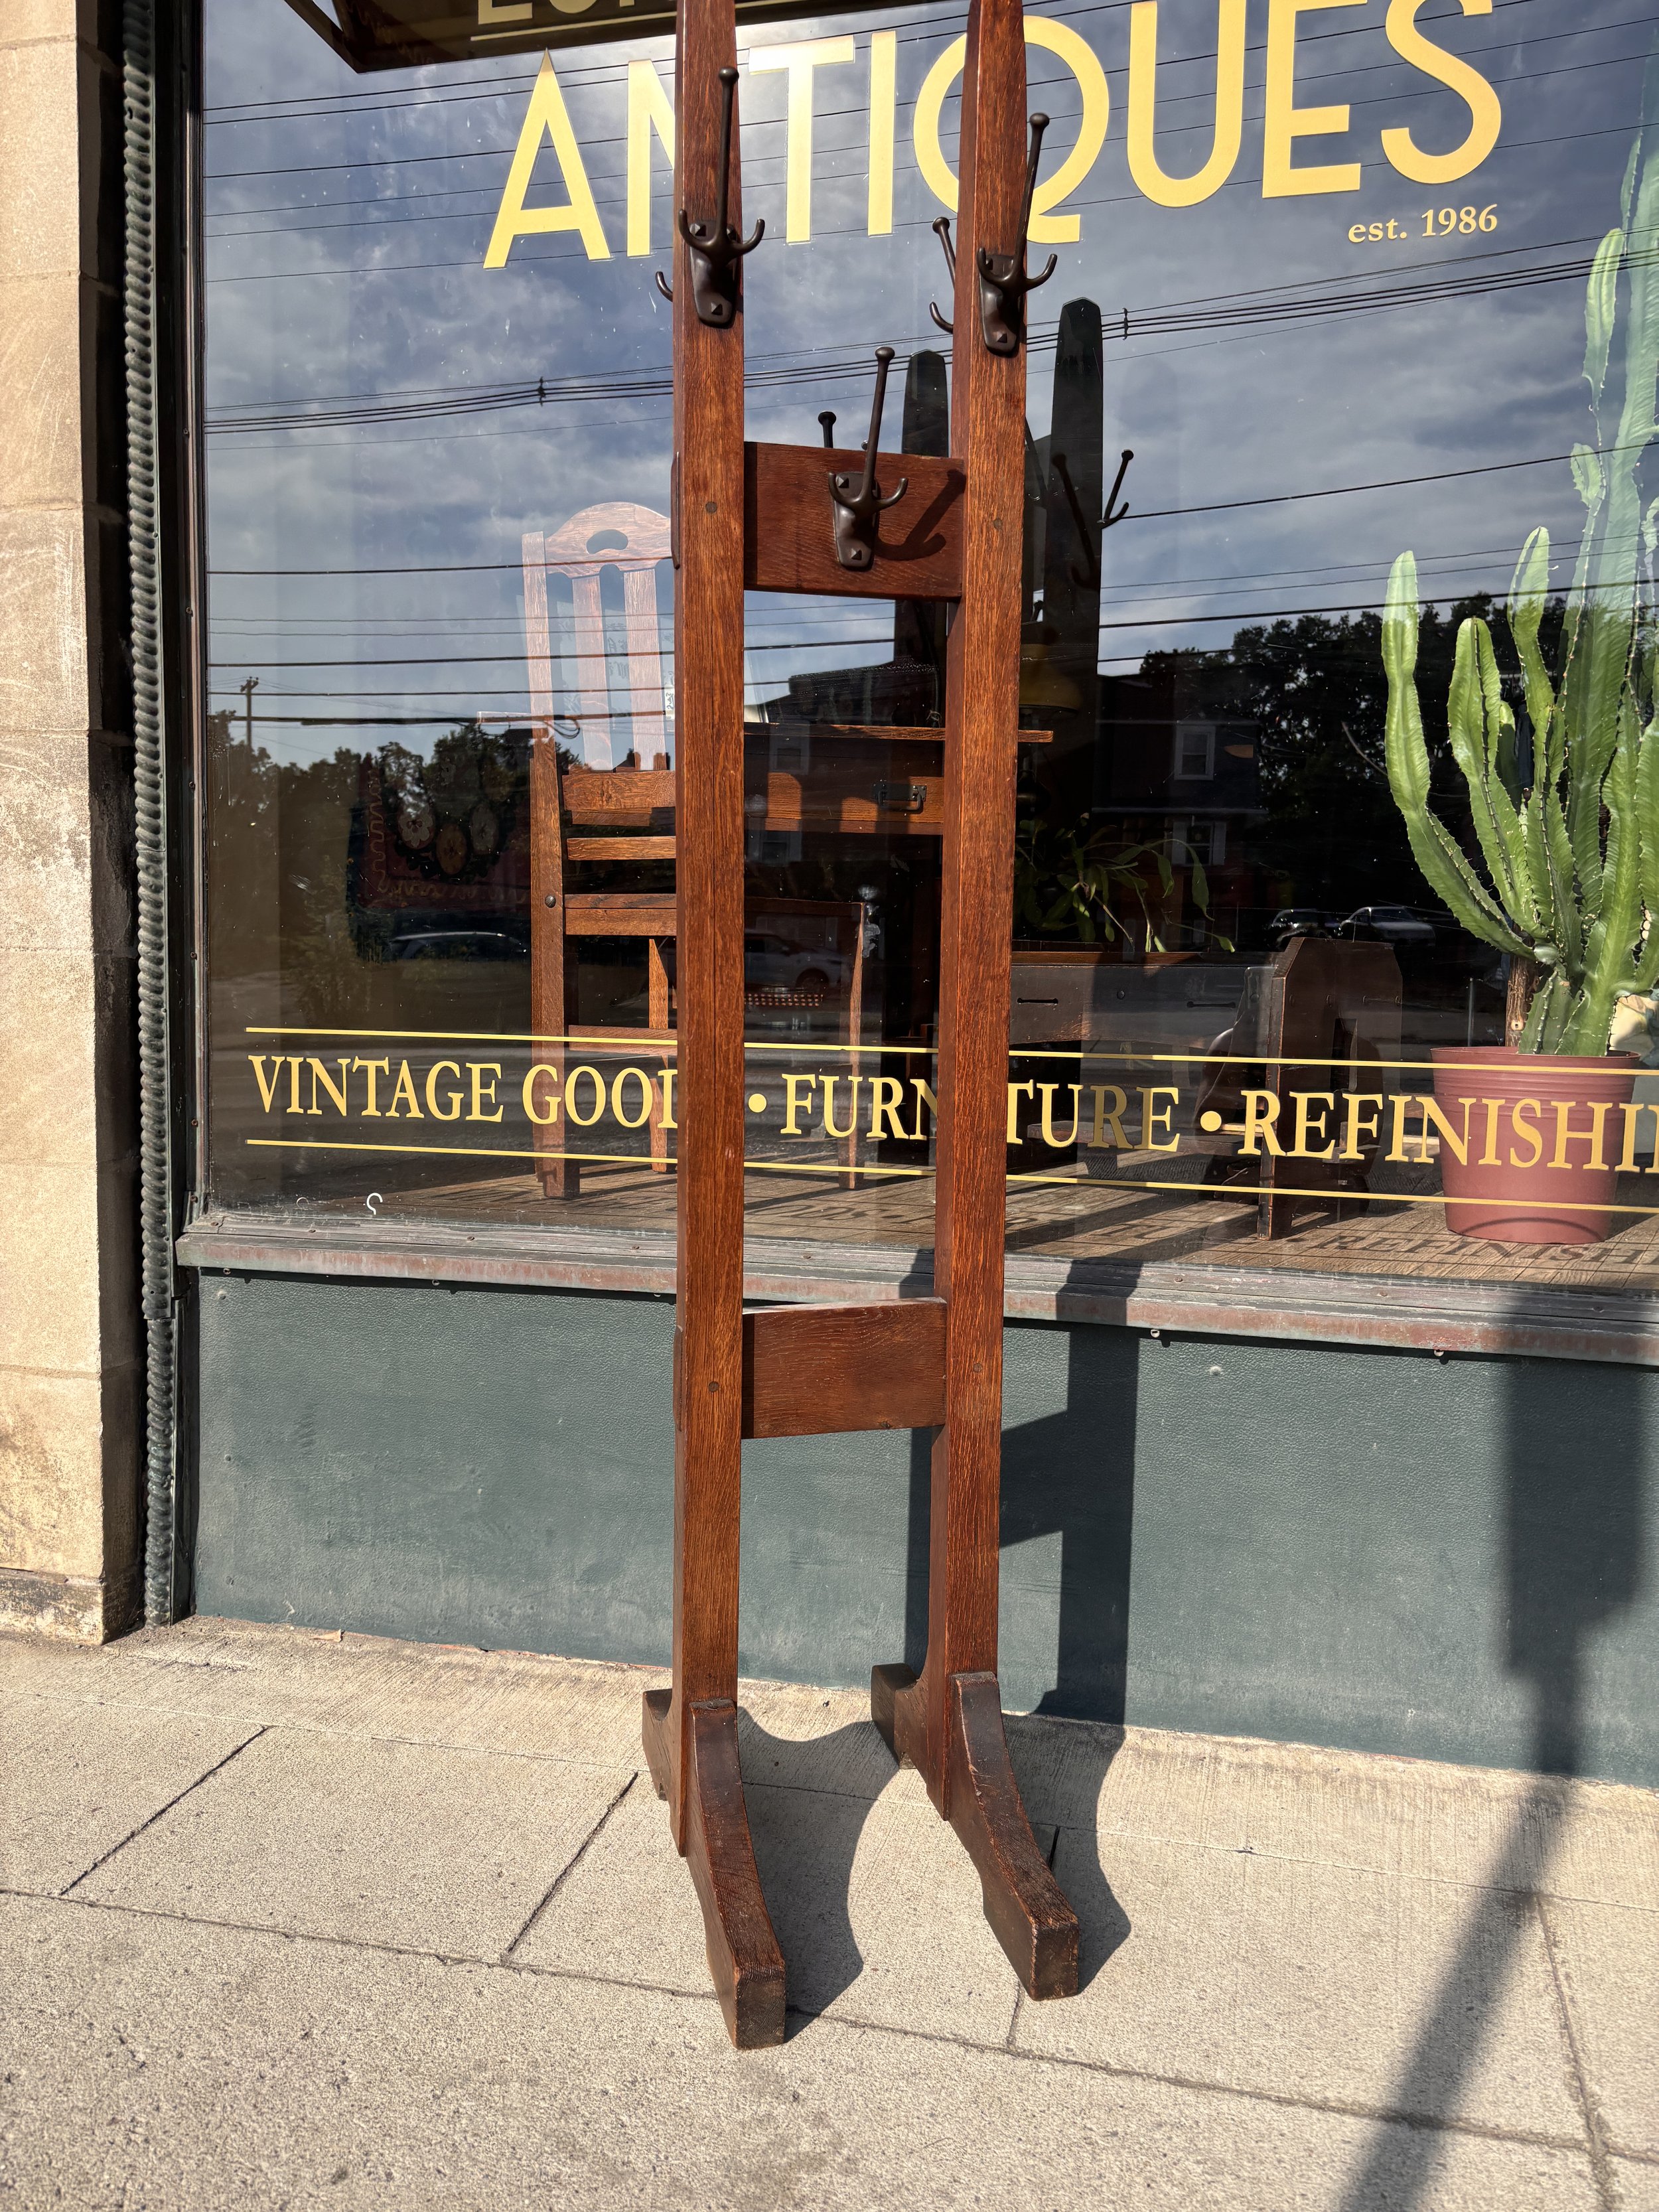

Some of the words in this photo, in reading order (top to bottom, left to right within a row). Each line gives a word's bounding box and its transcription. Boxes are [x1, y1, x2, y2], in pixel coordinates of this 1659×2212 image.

[1348, 218, 1407, 243] est.
[1421, 204, 1498, 237] 1986
[248, 1055, 504, 1122] VINTAGE
[780, 1073, 1180, 1153] FURNTURE
[1238, 1090, 1659, 1174] REFINISHI
